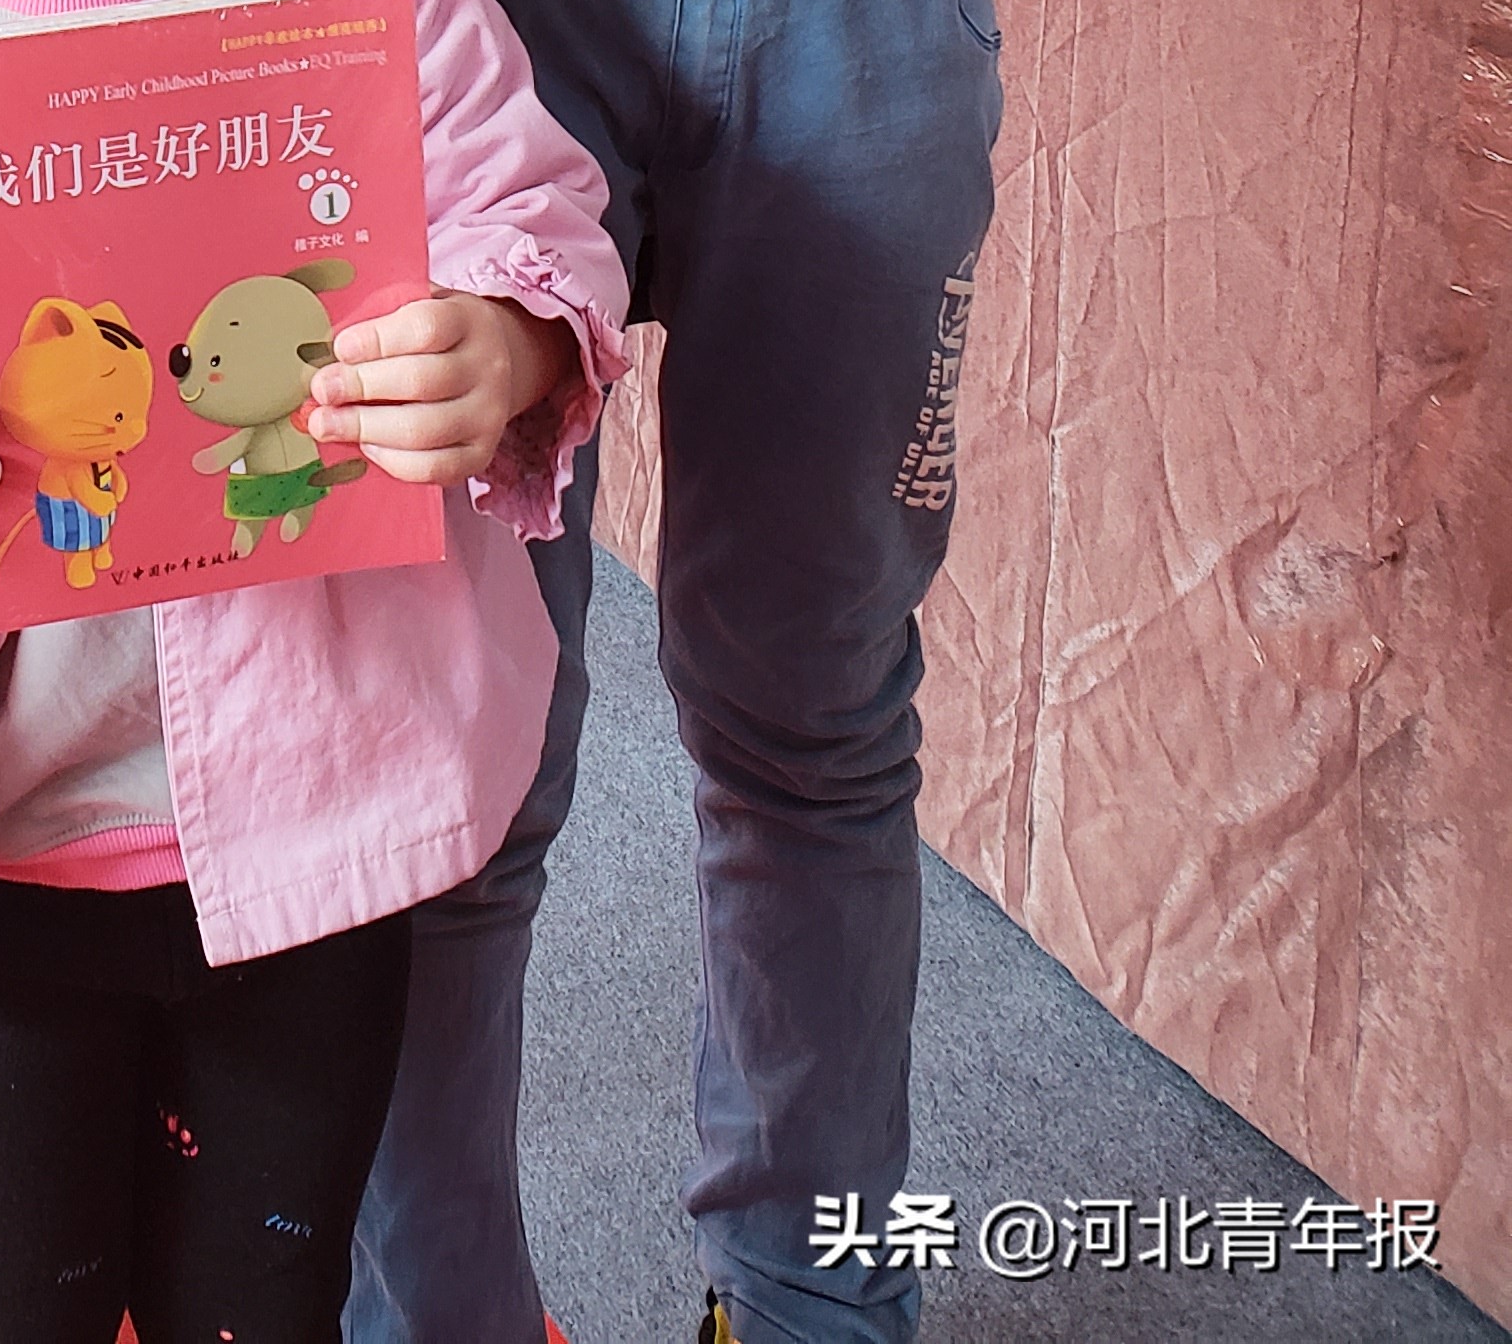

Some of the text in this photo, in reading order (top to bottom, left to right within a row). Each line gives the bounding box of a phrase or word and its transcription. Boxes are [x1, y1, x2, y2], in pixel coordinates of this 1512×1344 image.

[48, 90, 101, 109] HAPPY
[103, 84, 138, 102] Early
[141, 70, 209, 95] Childhood
[210, 66, 256, 85] Picture
[258, 59, 300, 77] Books
[323, 191, 340, 219] 1
[915, 406, 934, 438] OF
